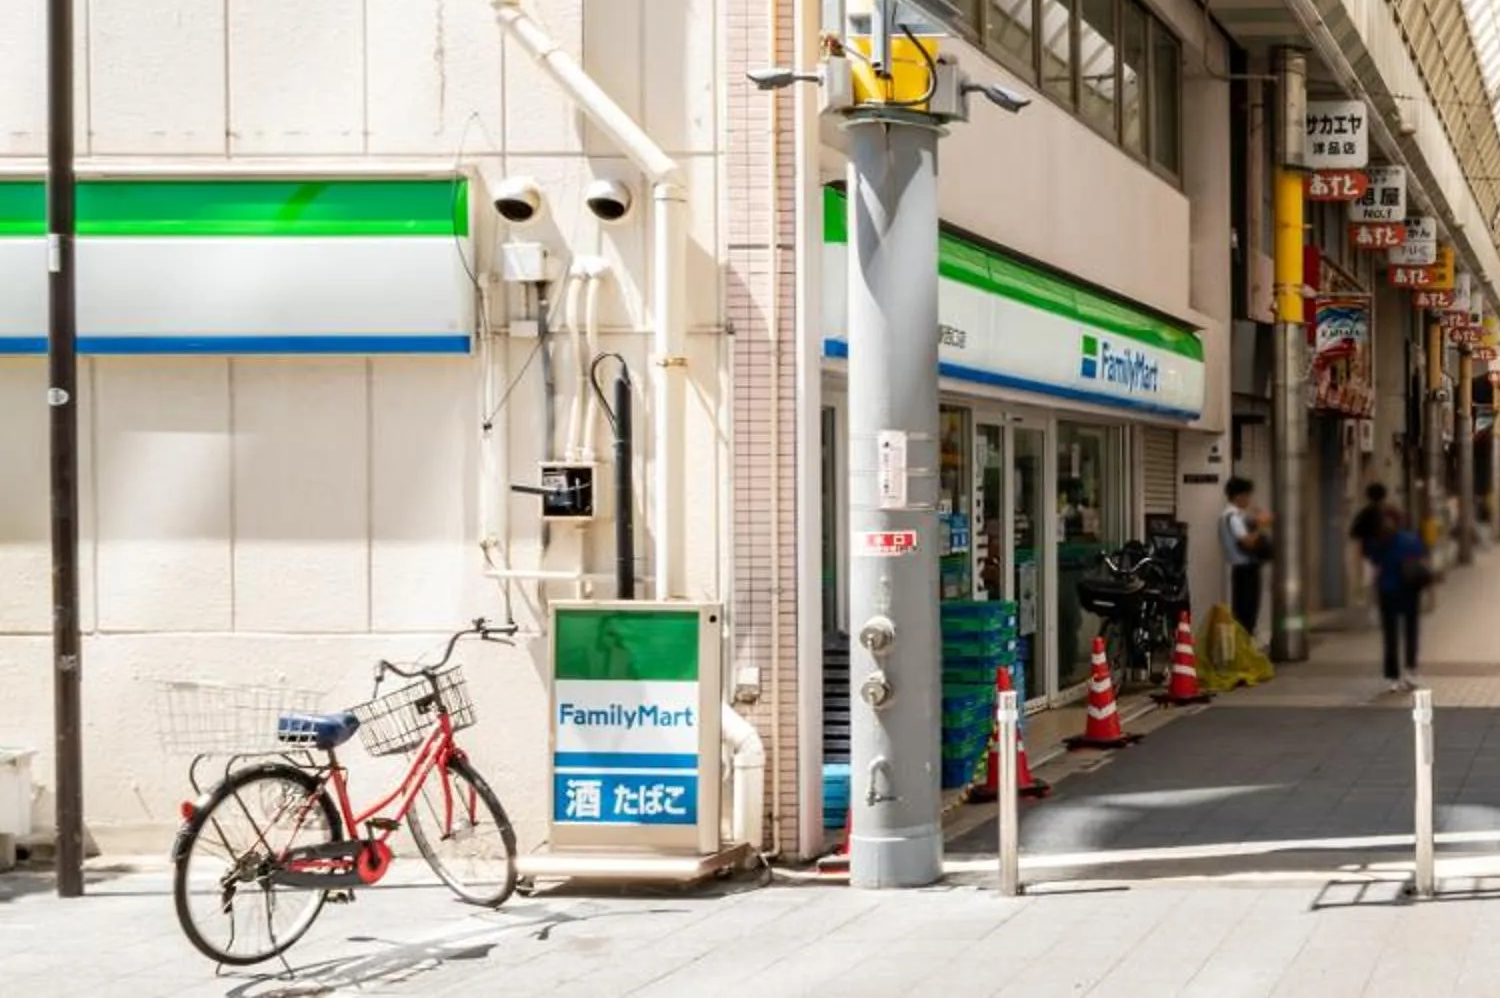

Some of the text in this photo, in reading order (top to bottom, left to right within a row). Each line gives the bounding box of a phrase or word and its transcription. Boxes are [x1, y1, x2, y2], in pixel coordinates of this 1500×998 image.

[1306, 113, 1363, 135] サカエヤ
[1309, 172, 1360, 197] あすと
[1356, 225, 1400, 246] あすと
[1394, 267, 1430, 285] あすと
[1101, 341, 1159, 393] FamilyMart
[560, 703, 694, 730] FamilyMart
[566, 779, 687, 818] 酒 たばこ
